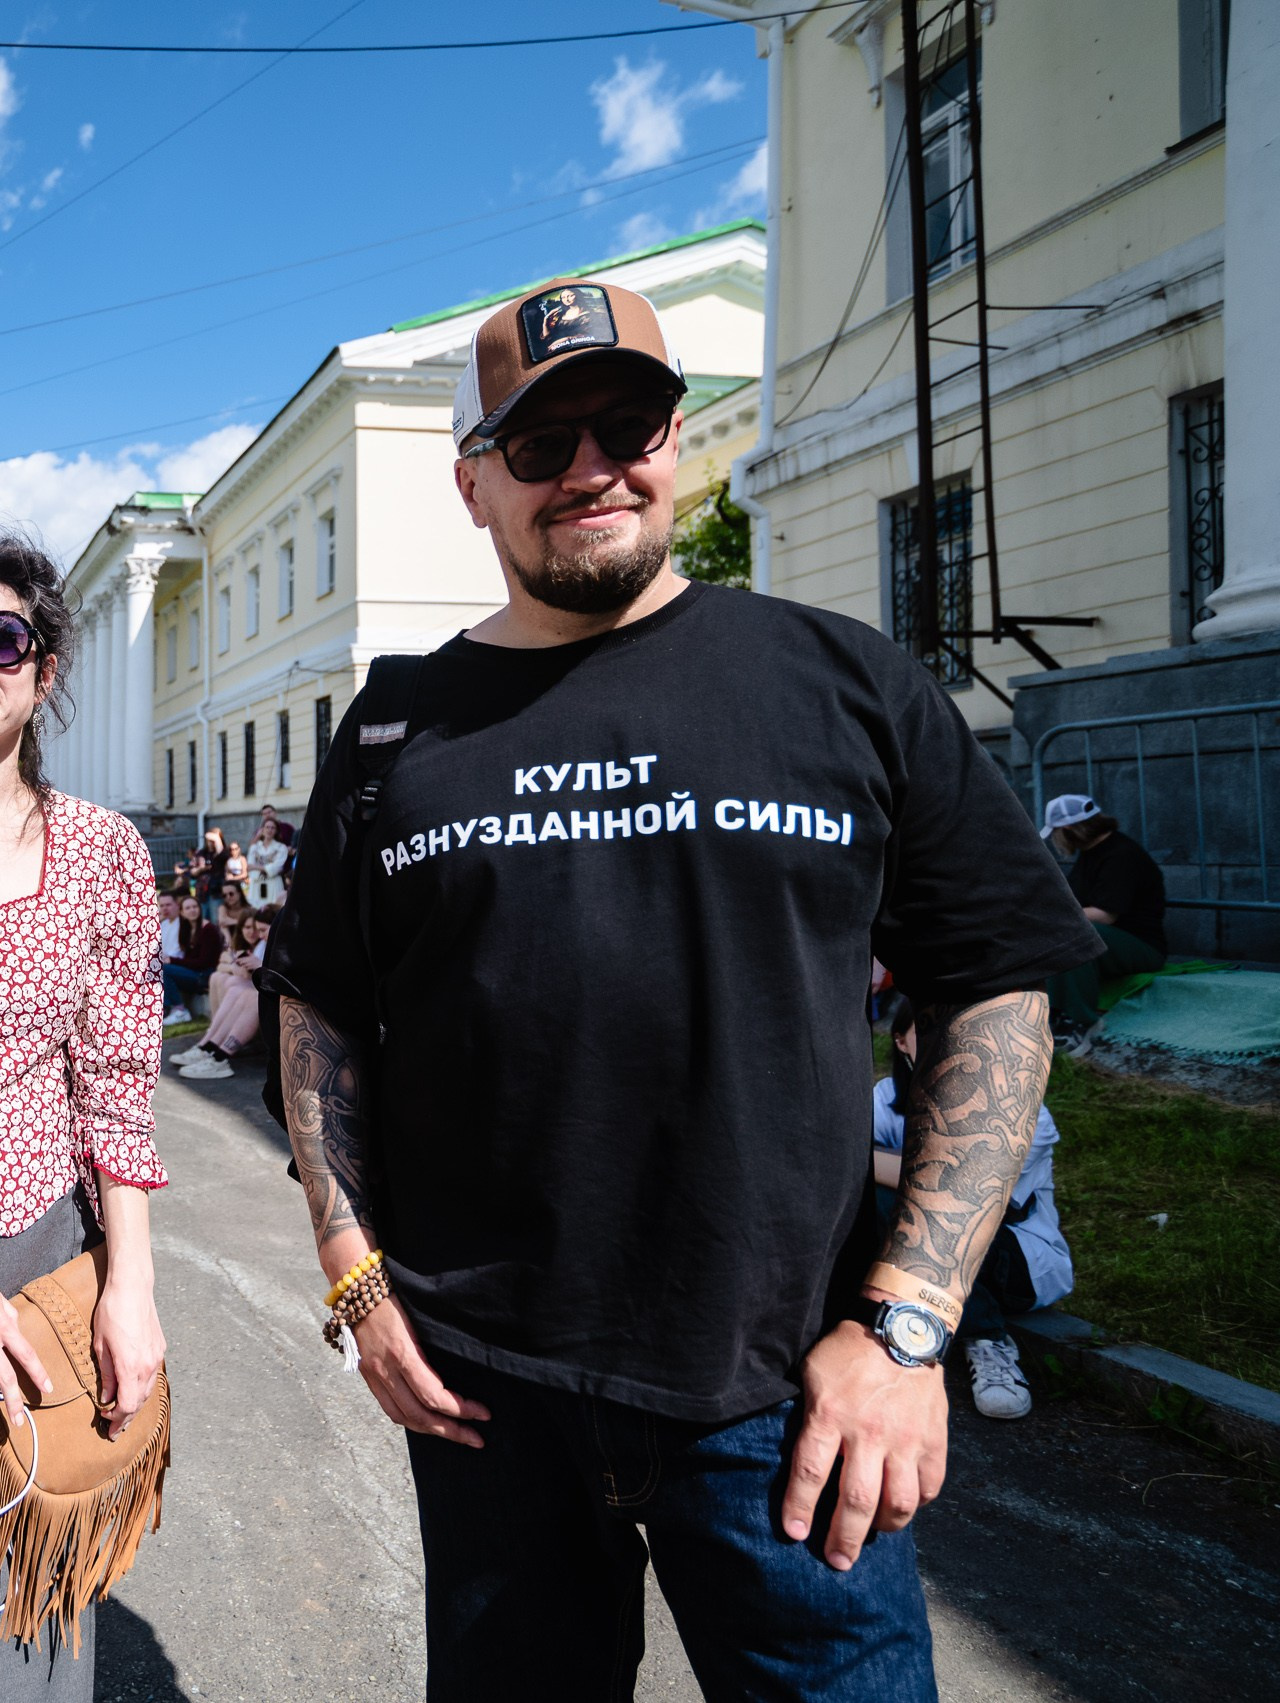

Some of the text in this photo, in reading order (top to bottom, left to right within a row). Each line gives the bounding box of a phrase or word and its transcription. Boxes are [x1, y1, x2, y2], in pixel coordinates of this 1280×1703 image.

[514, 754, 658, 795] КУЛЬТ
[380, 791, 853, 876] РАЗНУЗДАННОЙ СИЛЫ
